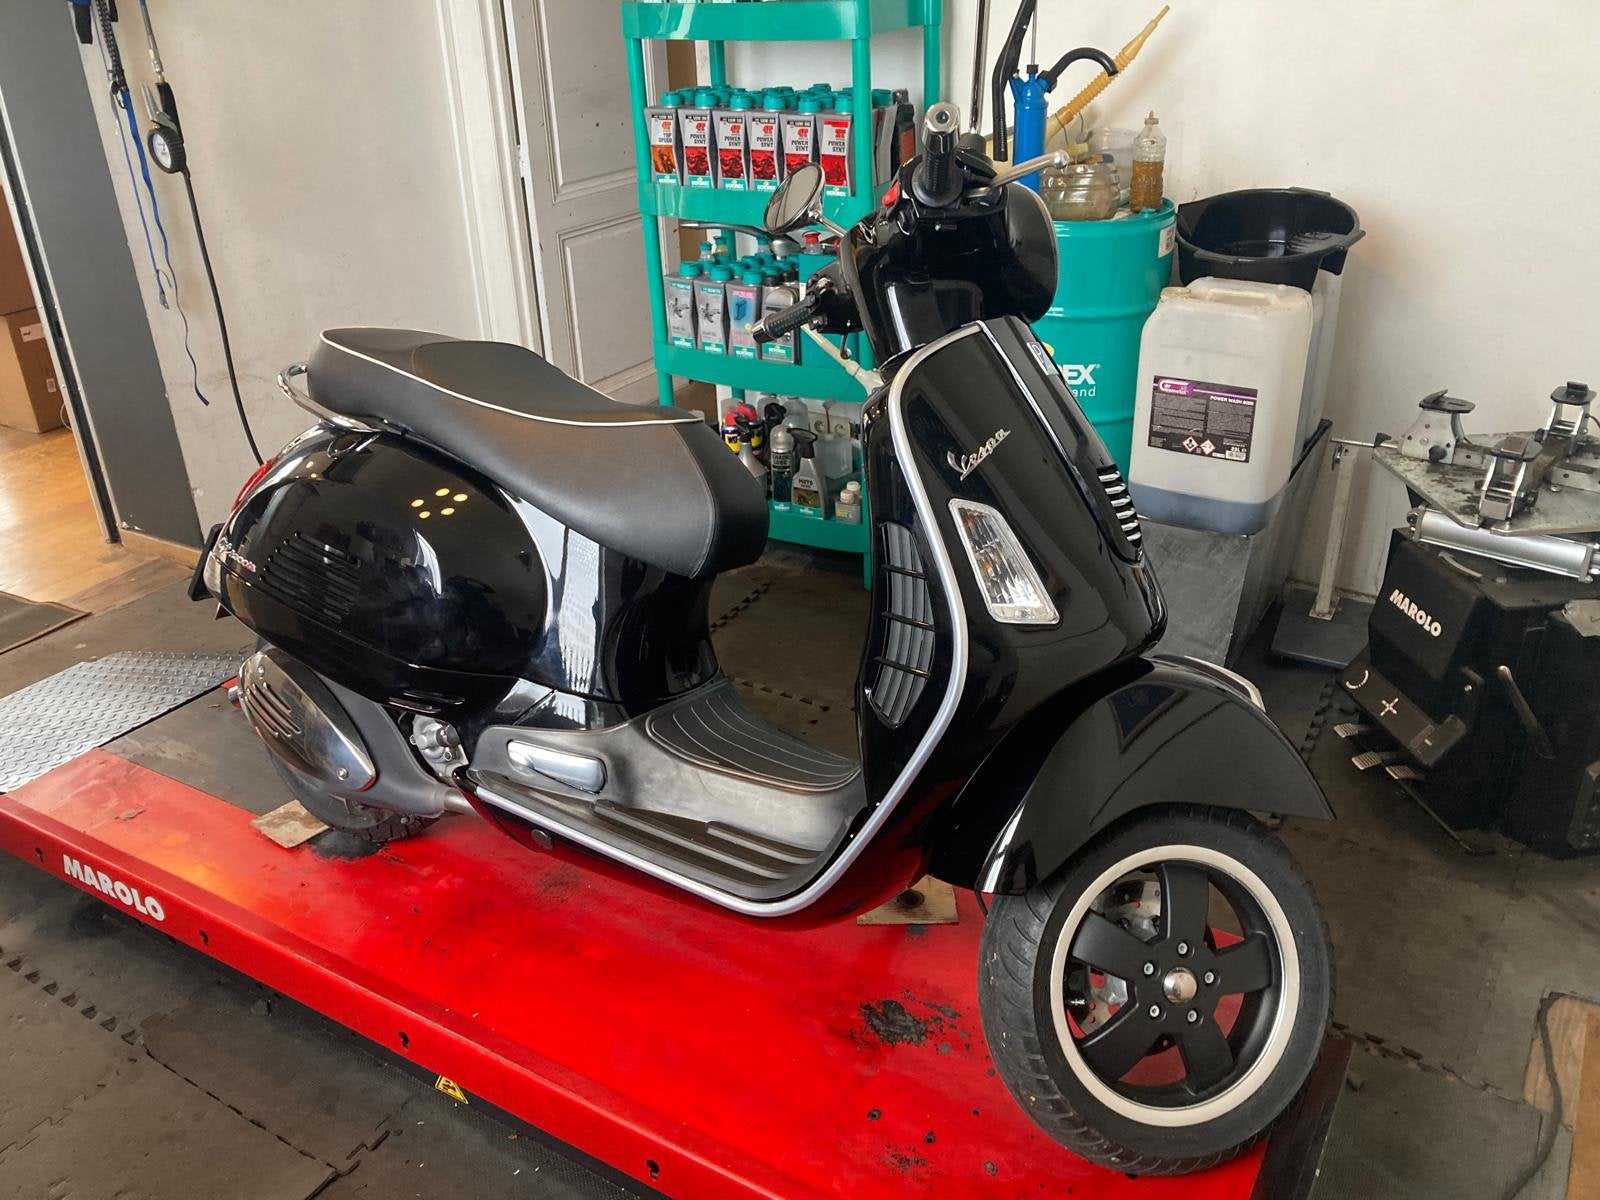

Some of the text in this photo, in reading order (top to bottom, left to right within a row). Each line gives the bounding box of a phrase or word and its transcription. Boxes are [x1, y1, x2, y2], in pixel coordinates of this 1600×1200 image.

[1057, 364, 1096, 385] EX
[947, 429, 1011, 481] Vespa
[1390, 589, 1441, 637] MAROLO
[63, 854, 165, 921] MAROLO
